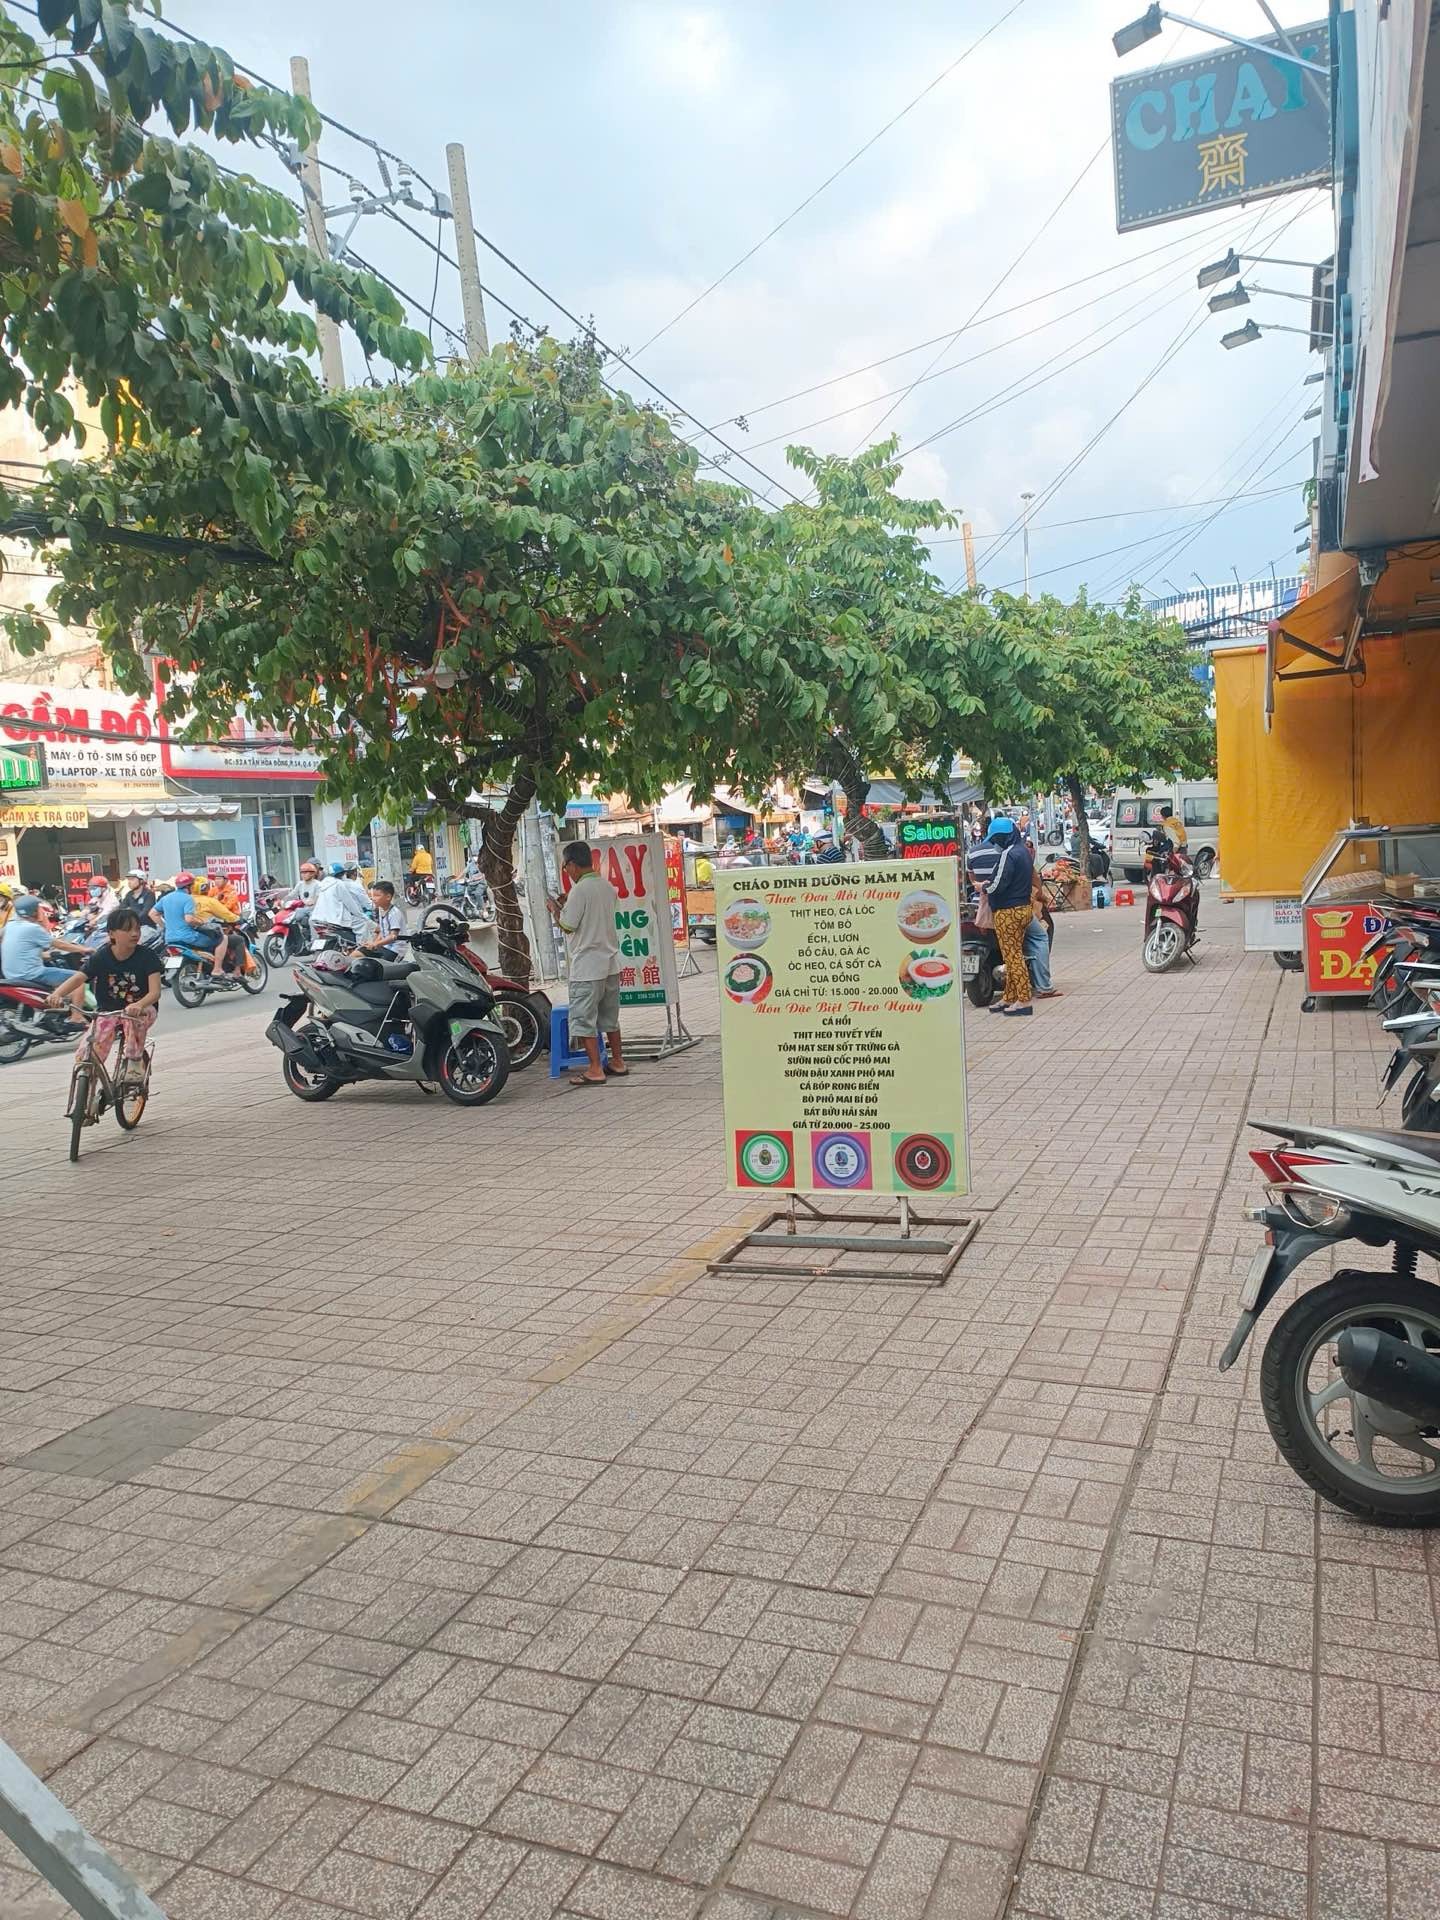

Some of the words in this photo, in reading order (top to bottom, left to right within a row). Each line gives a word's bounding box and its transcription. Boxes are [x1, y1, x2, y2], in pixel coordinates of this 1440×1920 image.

[1125, 44, 1319, 150] CHAY
[1, 691, 90, 743] CẦM
[101, 698, 151, 745] ĐỒ
[106, 752, 122, 762] SIM
[62, 767, 98, 776] LAPTOP
[105, 768, 116, 776] XE
[28, 811, 39, 822] XE
[903, 823, 956, 842] Salon
[137, 856, 149, 872] XE
[71, 879, 88, 889] XE
[733, 878, 770, 891] CHÁO
[774, 878, 807, 890] DINH
[812, 873, 860, 888] DƯỠNG
[790, 909, 811, 919] THỊT
[814, 908, 836, 918] HEO,
[840, 906, 852, 916] CÁ
[814, 920, 834, 930] TÔM
[833, 933, 859, 943] LƯƠN
[804, 962, 827, 970] HEO,
[830, 960, 843, 970] CÁ
[846, 956, 864, 968] SỐT
[810, 974, 829, 983] CUA
[775, 988, 790, 997] GIÁ
[794, 986, 810, 996] CHỈ
[832, 988, 860, 996] 15.000
[868, 986, 898, 995] 20.000
[848, 1000, 880, 1012] Theo
[822, 1016, 834, 1026] CÁ
[794, 1031, 812, 1040] THỊT
[778, 1042, 796, 1052] TÔM
[798, 1044, 816, 1053] HẠT
[817, 1044, 834, 1052] SEN
[836, 1040, 854, 1052] SỐT
[888, 1042, 900, 1051] GÀ
[834, 1053, 851, 1064] CỐC
[874, 1056, 890, 1064] MAI
[830, 1070, 856, 1078] XANH
[878, 1070, 894, 1078] MAI
[800, 1080, 812, 1090] CÁ
[832, 1082, 857, 1090] RONG
[858, 1078, 880, 1090] BIỂN
[836, 1096, 853, 1104] MAI
[854, 1094, 864, 1104] BÍ
[804, 1106, 820, 1116] BÁT
[842, 1106, 858, 1116] HẢI
[793, 1120, 808, 1129] GIÁ
[822, 1121, 852, 1130] 20.000
[860, 1121, 891, 1130] 25.000
